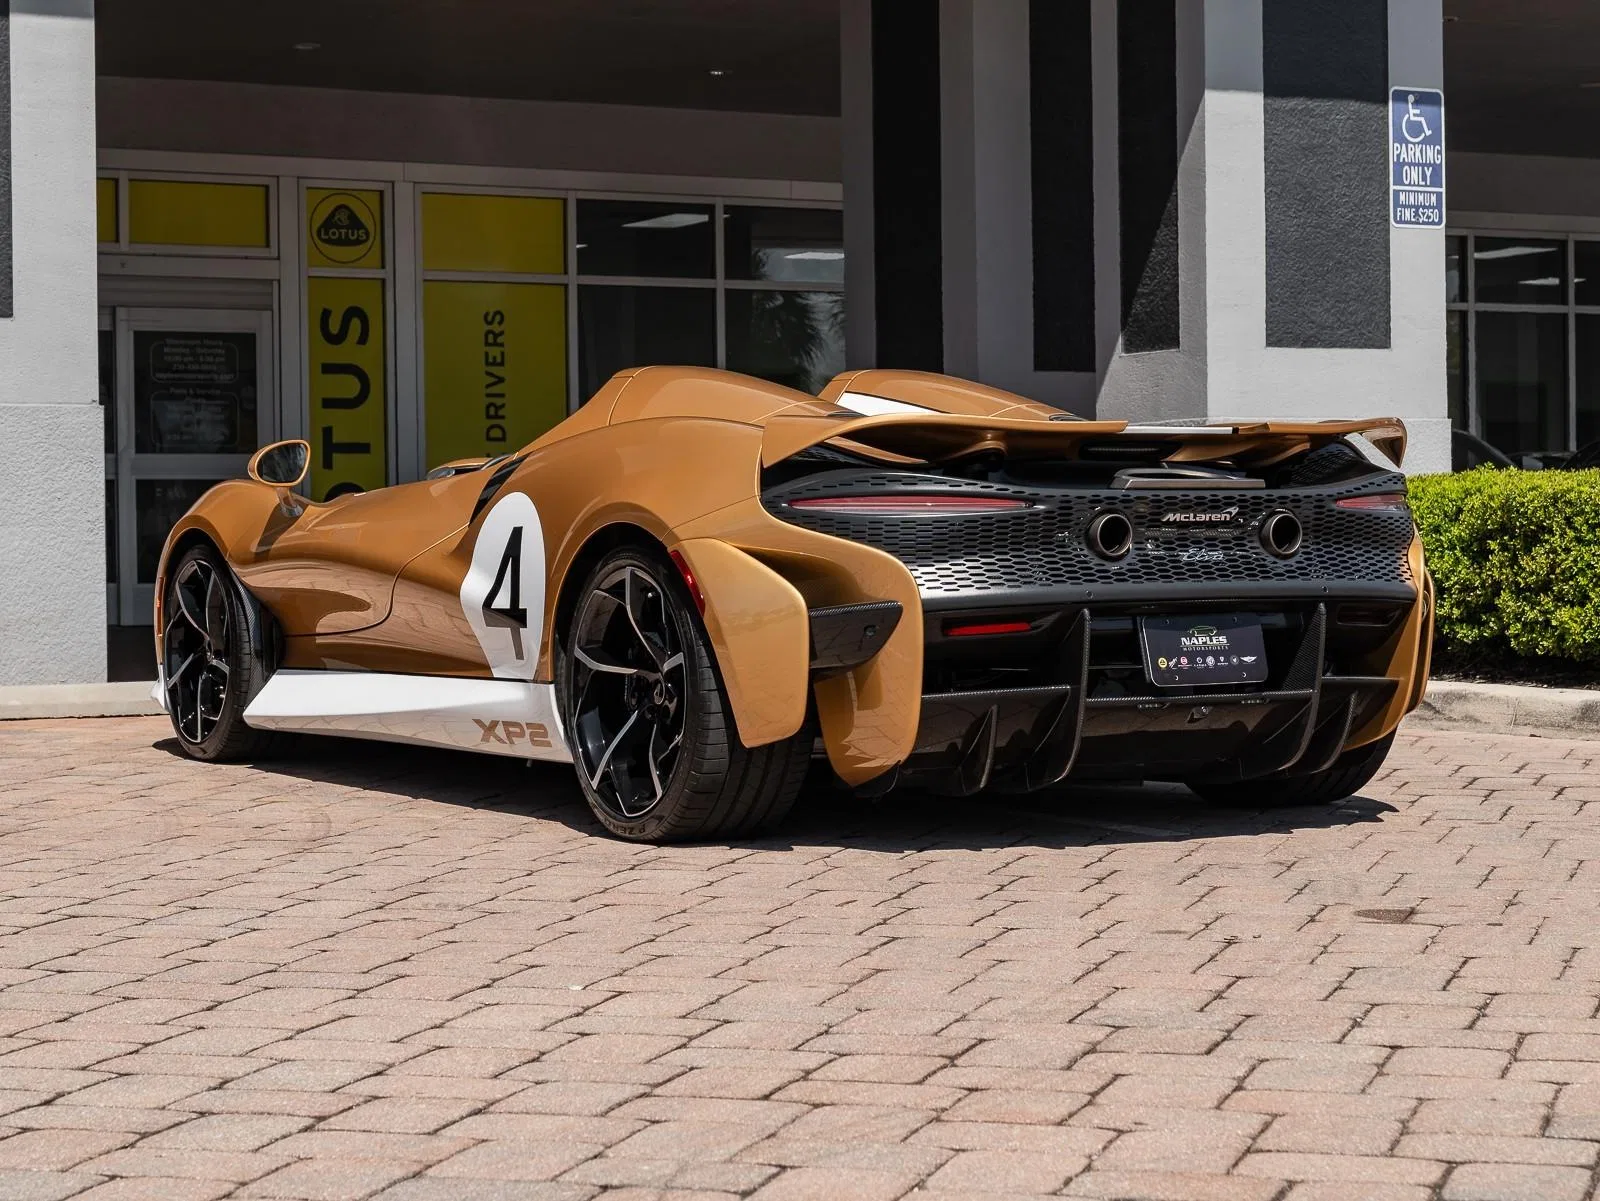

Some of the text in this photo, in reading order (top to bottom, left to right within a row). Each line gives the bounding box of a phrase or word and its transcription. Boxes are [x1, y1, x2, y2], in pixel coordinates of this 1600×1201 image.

[1394, 143, 1441, 164] PARKING
[1402, 166, 1432, 185] ONLY
[1400, 192, 1436, 206] MINIMUM
[1397, 207, 1439, 223] FINE $250
[321, 228, 367, 240] LOTUS
[484, 310, 506, 442] DRIVERS
[1162, 513, 1231, 522] McLaren
[482, 526, 527, 660] 4
[1180, 635, 1228, 646] NAPLES
[472, 718, 553, 748] XP2
